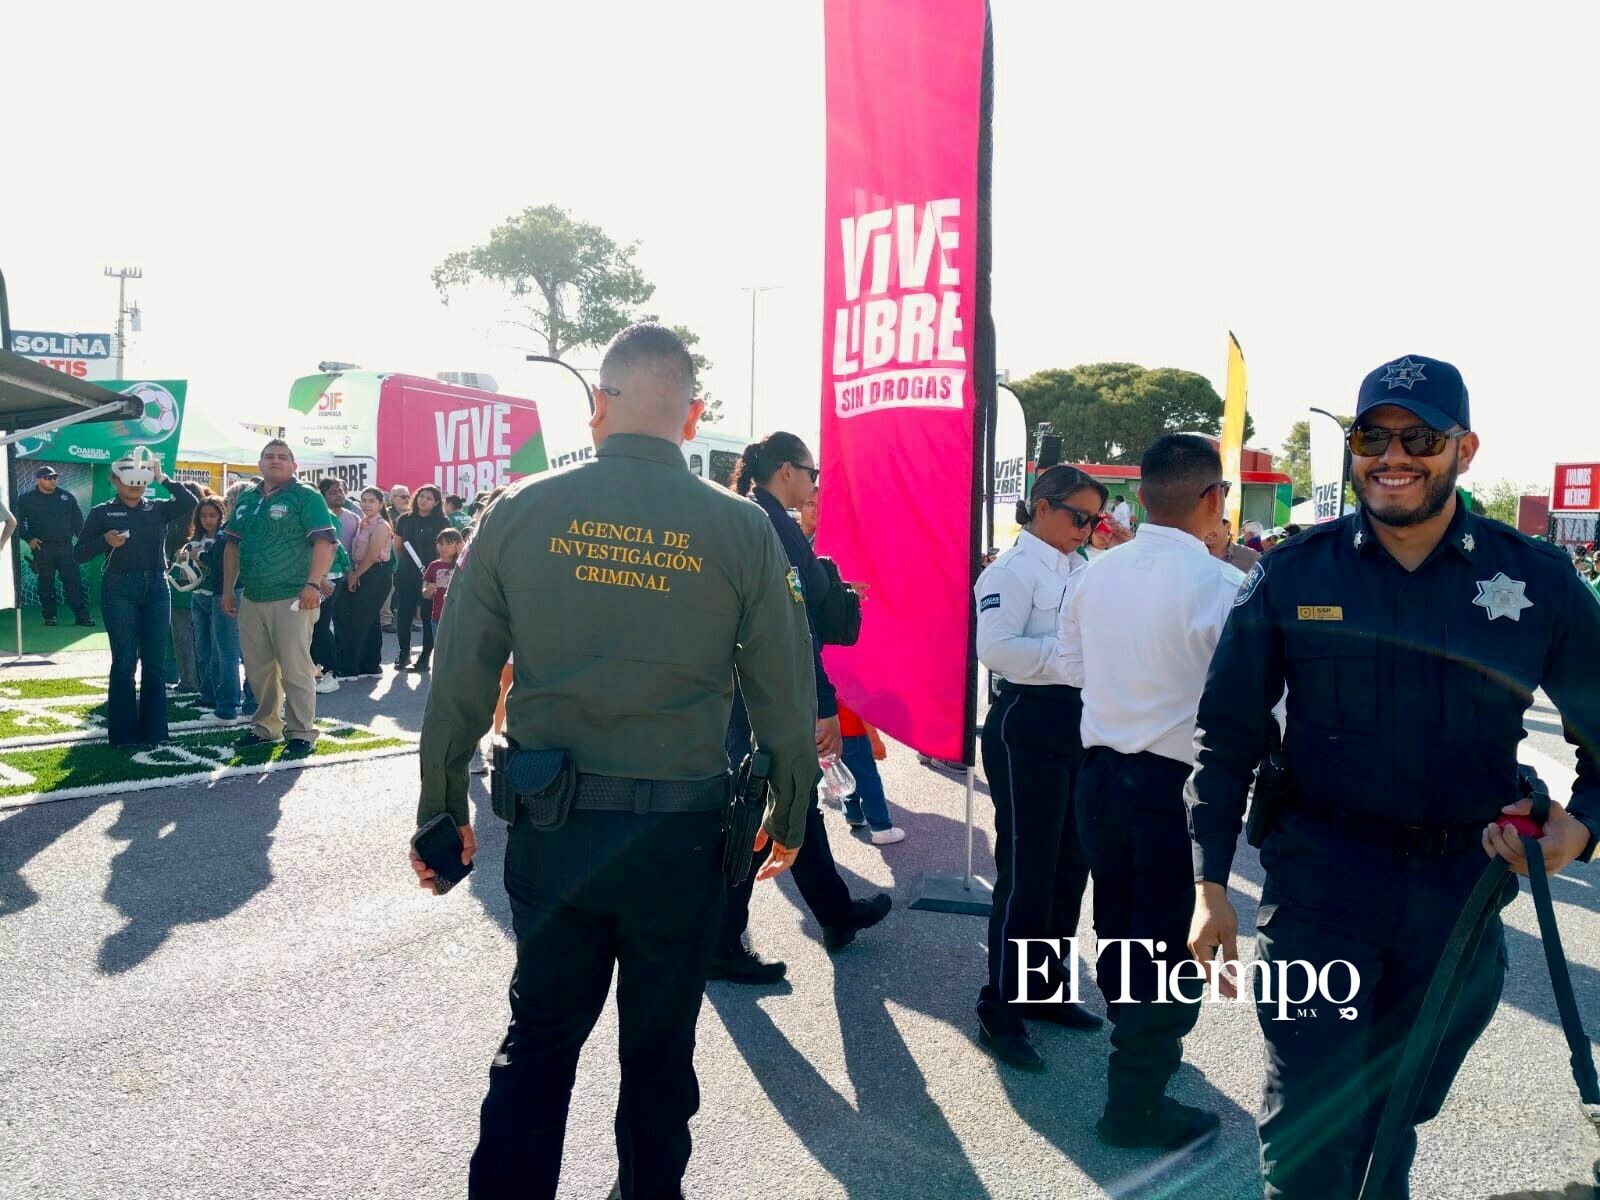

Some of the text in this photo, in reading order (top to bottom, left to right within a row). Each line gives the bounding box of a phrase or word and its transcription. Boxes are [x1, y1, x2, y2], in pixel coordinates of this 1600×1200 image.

[840, 198, 960, 301] VIVE
[12, 335, 107, 355] SOLINA
[832, 291, 966, 375] LIBRE
[842, 376, 952, 412] SIN DROGAS
[434, 403, 512, 462] VIVE
[995, 457, 1024, 478] VIVE
[568, 519, 690, 549] AGENCIA DE
[549, 537, 704, 573] INVESTIGACIÓN
[575, 565, 671, 592] CRIMINAL
